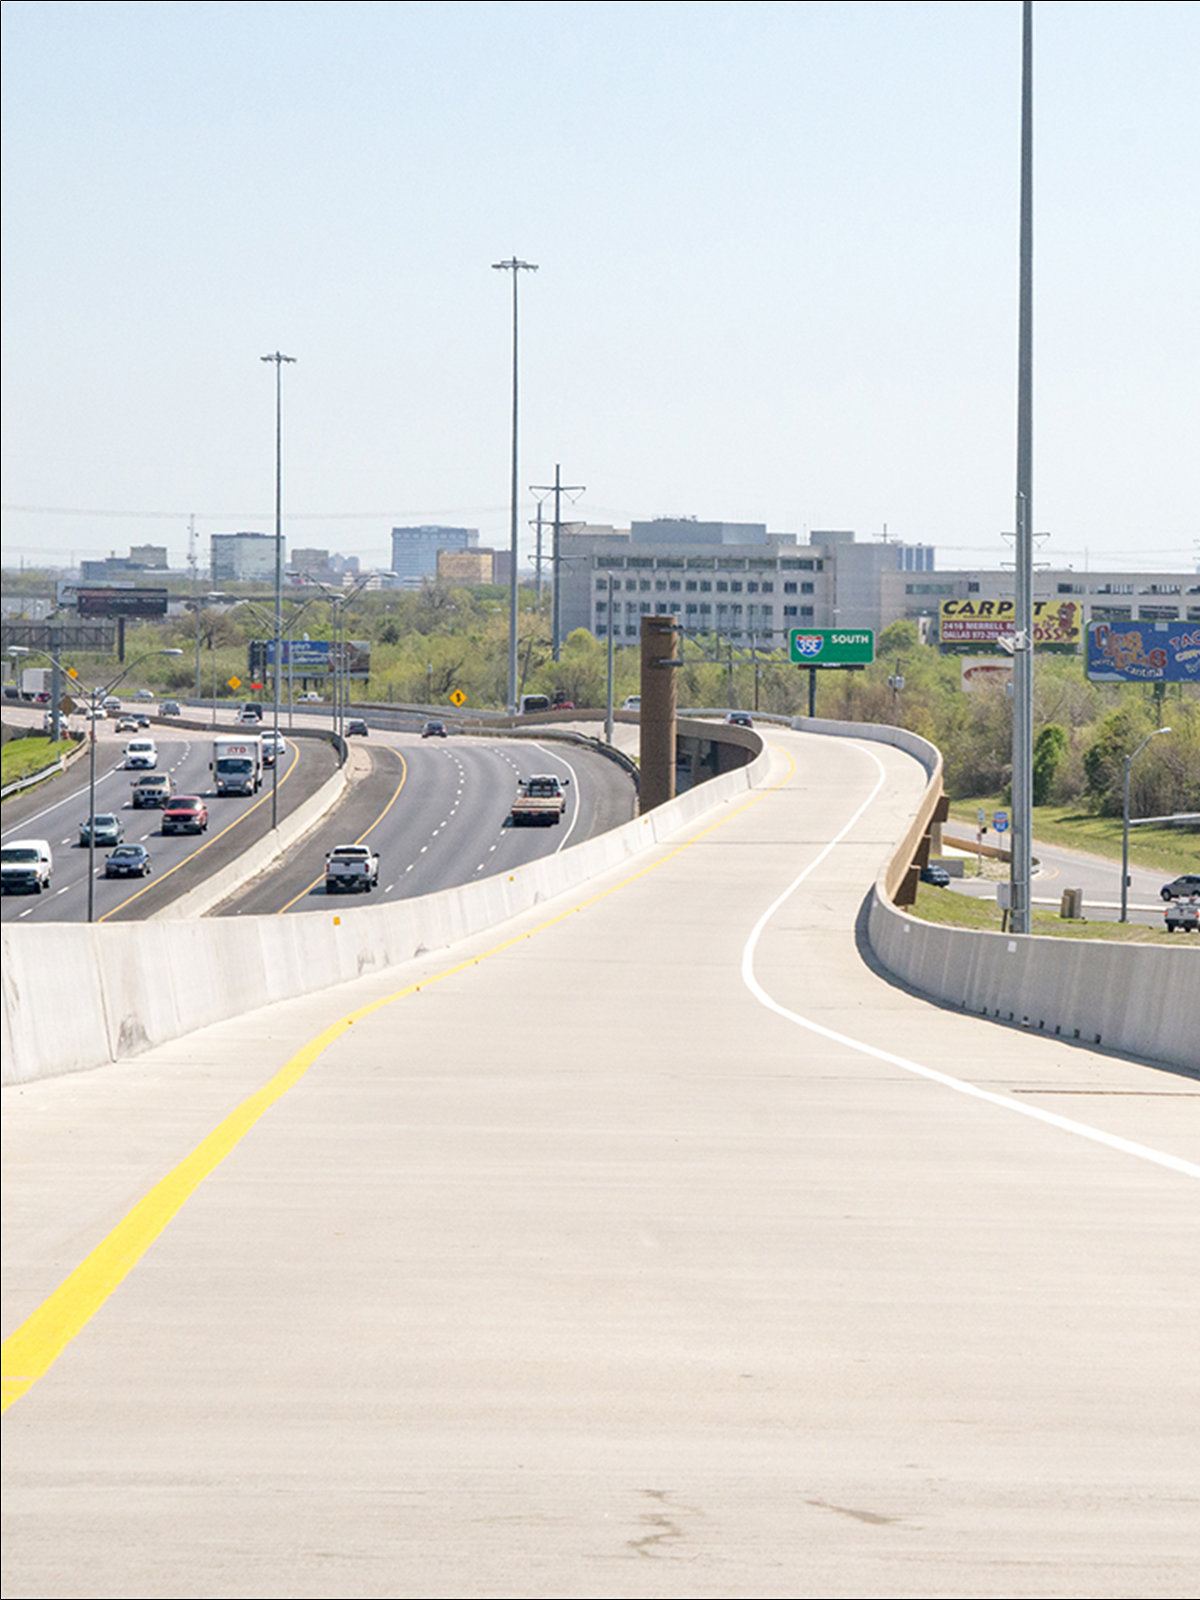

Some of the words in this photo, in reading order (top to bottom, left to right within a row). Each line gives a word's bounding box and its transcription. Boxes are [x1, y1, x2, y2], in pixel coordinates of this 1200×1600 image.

[943, 600, 1047, 616] CARPT
[831, 635, 869, 644] SOUTH
[800, 640, 819, 652] 35E
